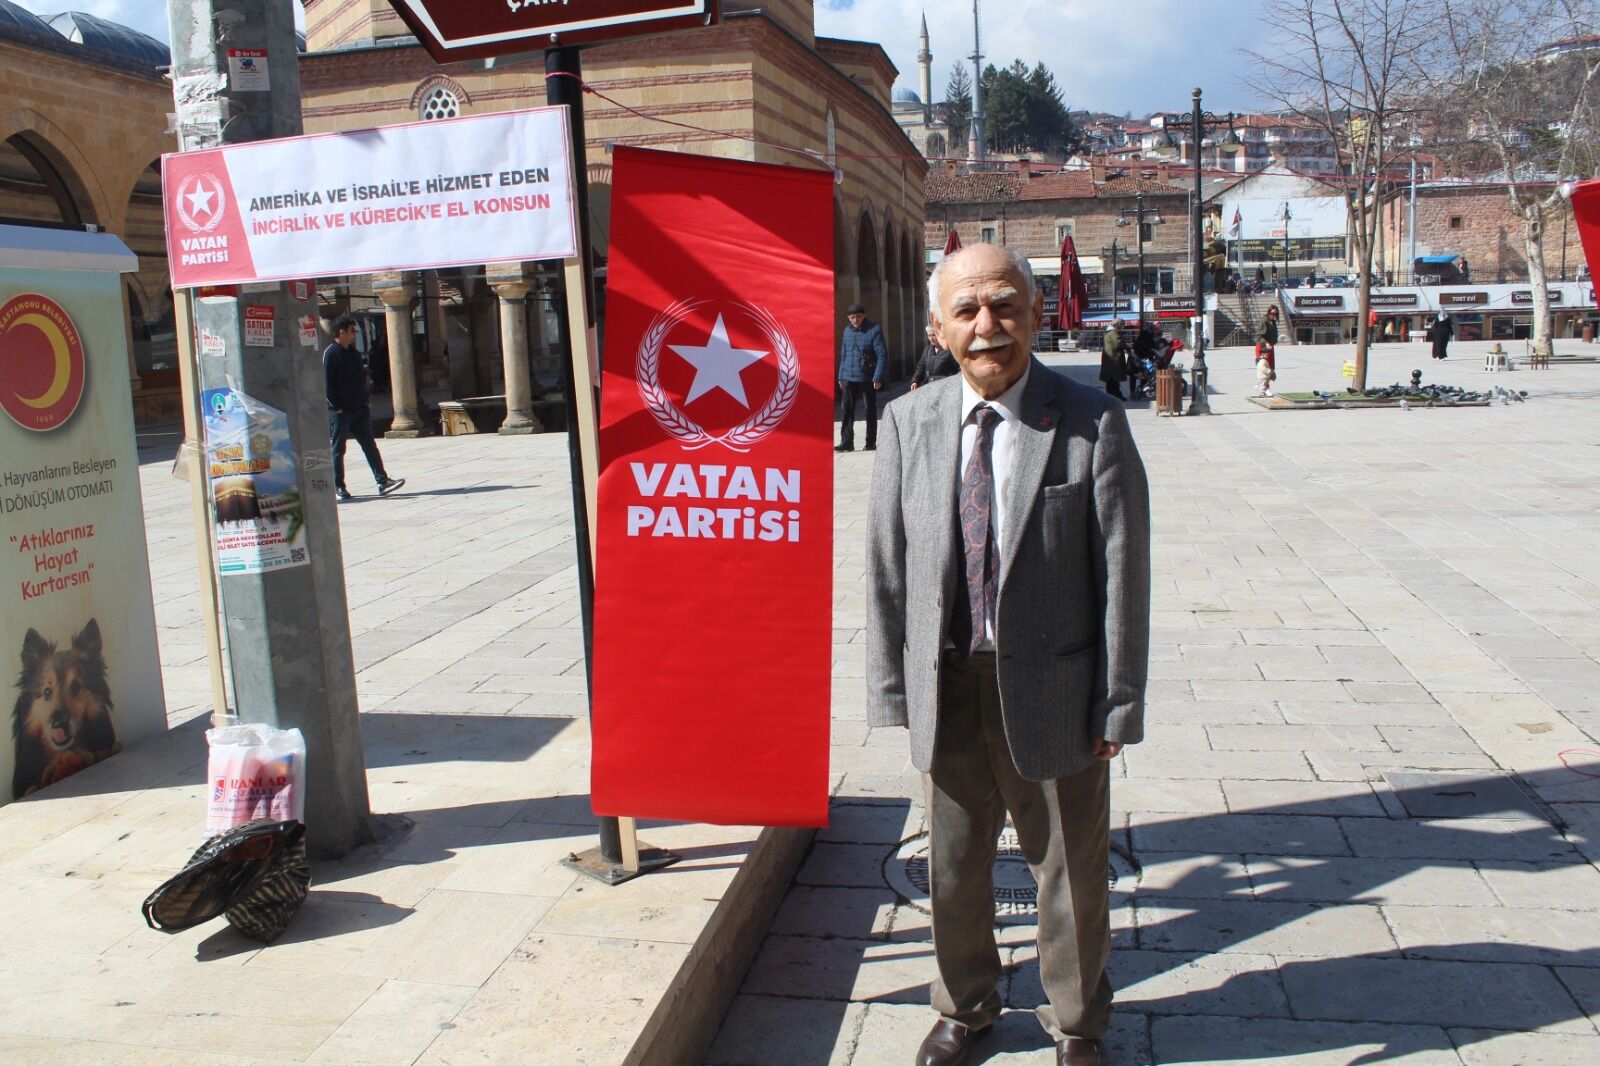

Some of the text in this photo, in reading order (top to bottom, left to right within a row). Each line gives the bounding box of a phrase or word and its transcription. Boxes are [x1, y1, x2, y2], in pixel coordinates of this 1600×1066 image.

[250, 190, 322, 211] AMERİKA
[327, 188, 347, 203] VE
[426, 174, 493, 193] HİZMET
[499, 168, 549, 187] EDEN
[252, 213, 320, 235] İNCİRLİK
[324, 213, 345, 228] VE
[447, 203, 468, 217] EL
[474, 194, 550, 215] KONSUN
[181, 236, 227, 250] VATAN
[4, 458, 117, 488] Hayvanlarını Besleyen
[629, 462, 801, 503] VATAN
[6, 488, 65, 513] DÖNÜŞÜM
[34, 547, 78, 573] Hayat
